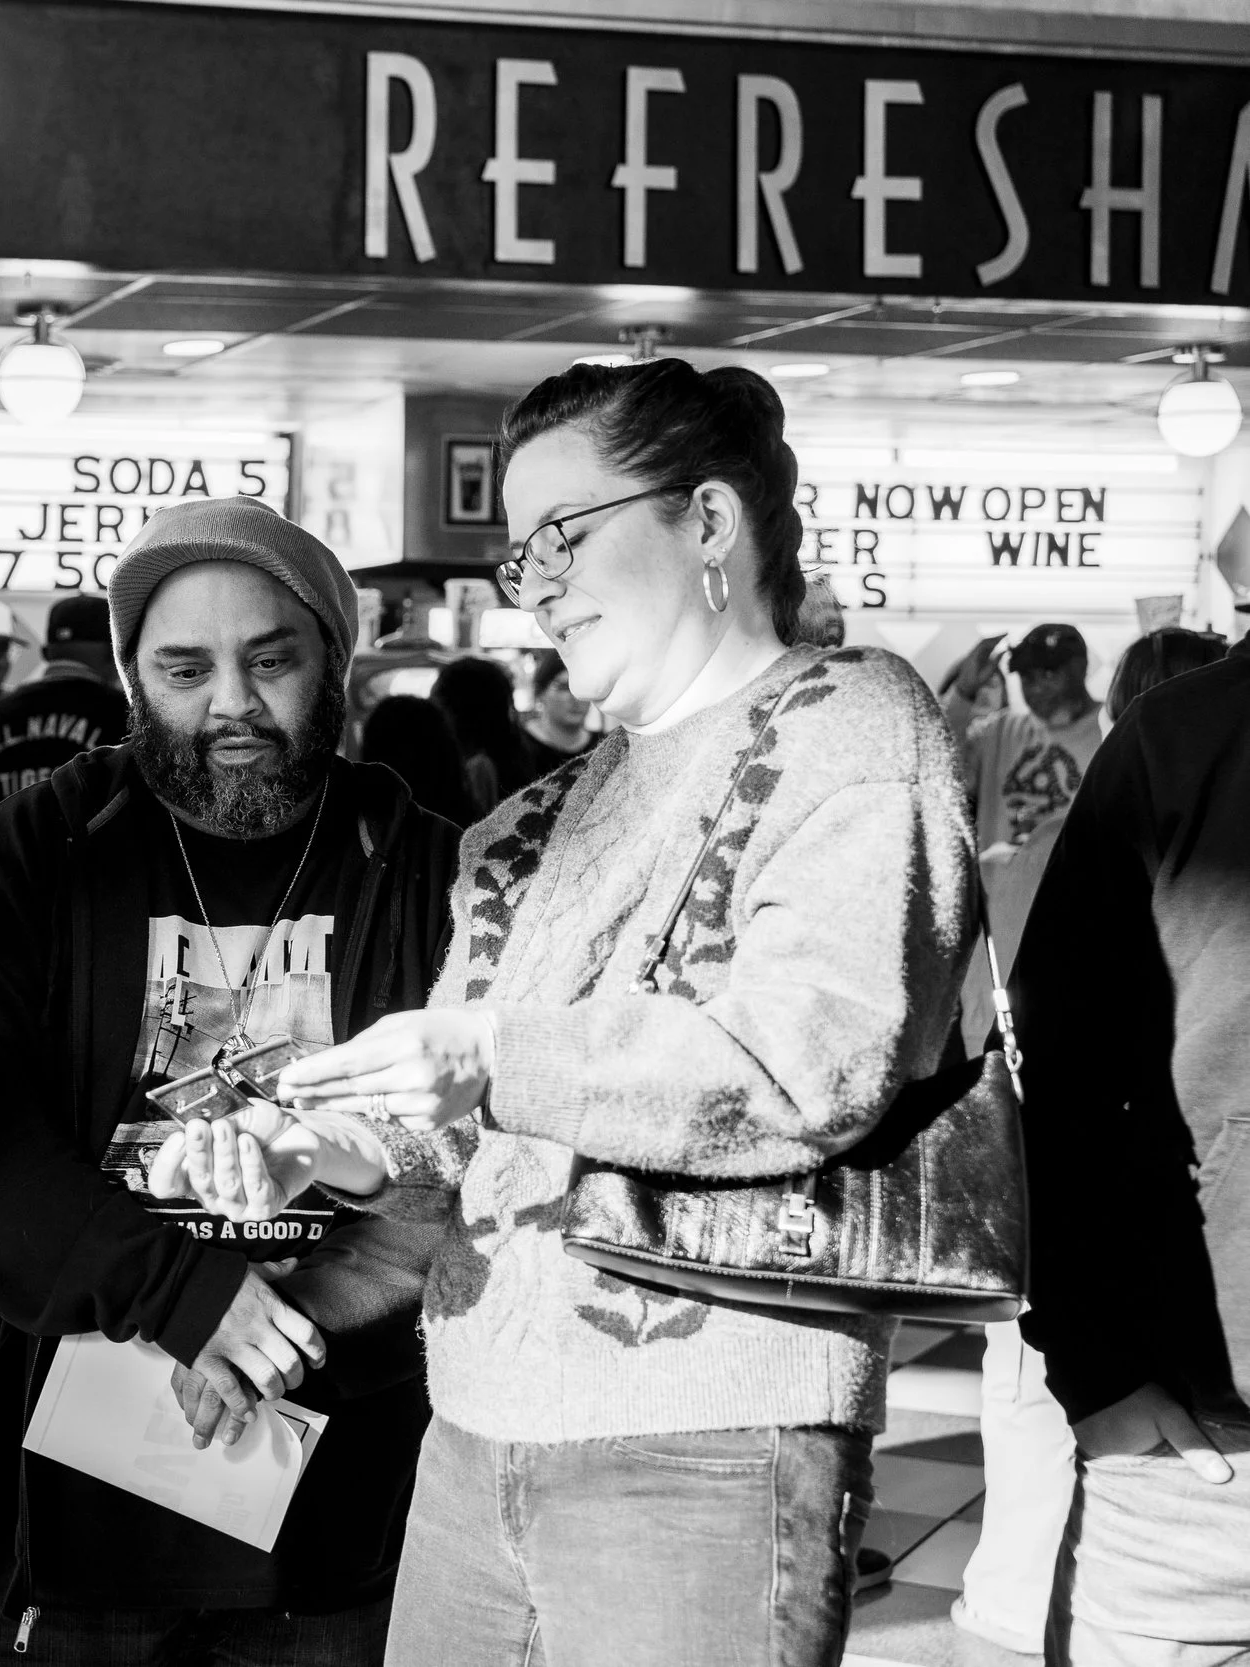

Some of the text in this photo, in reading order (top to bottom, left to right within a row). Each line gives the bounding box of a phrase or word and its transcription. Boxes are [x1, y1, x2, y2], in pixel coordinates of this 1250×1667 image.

[73, 456, 266, 496] SODA 5
[854, 484, 968, 520] NOW
[983, 487, 1106, 522] OPEN
[986, 532, 1102, 567] WINE
[164, 1221, 213, 1240] AS
[220, 1221, 237, 1239] A
[243, 1222, 303, 1240] GOOD
